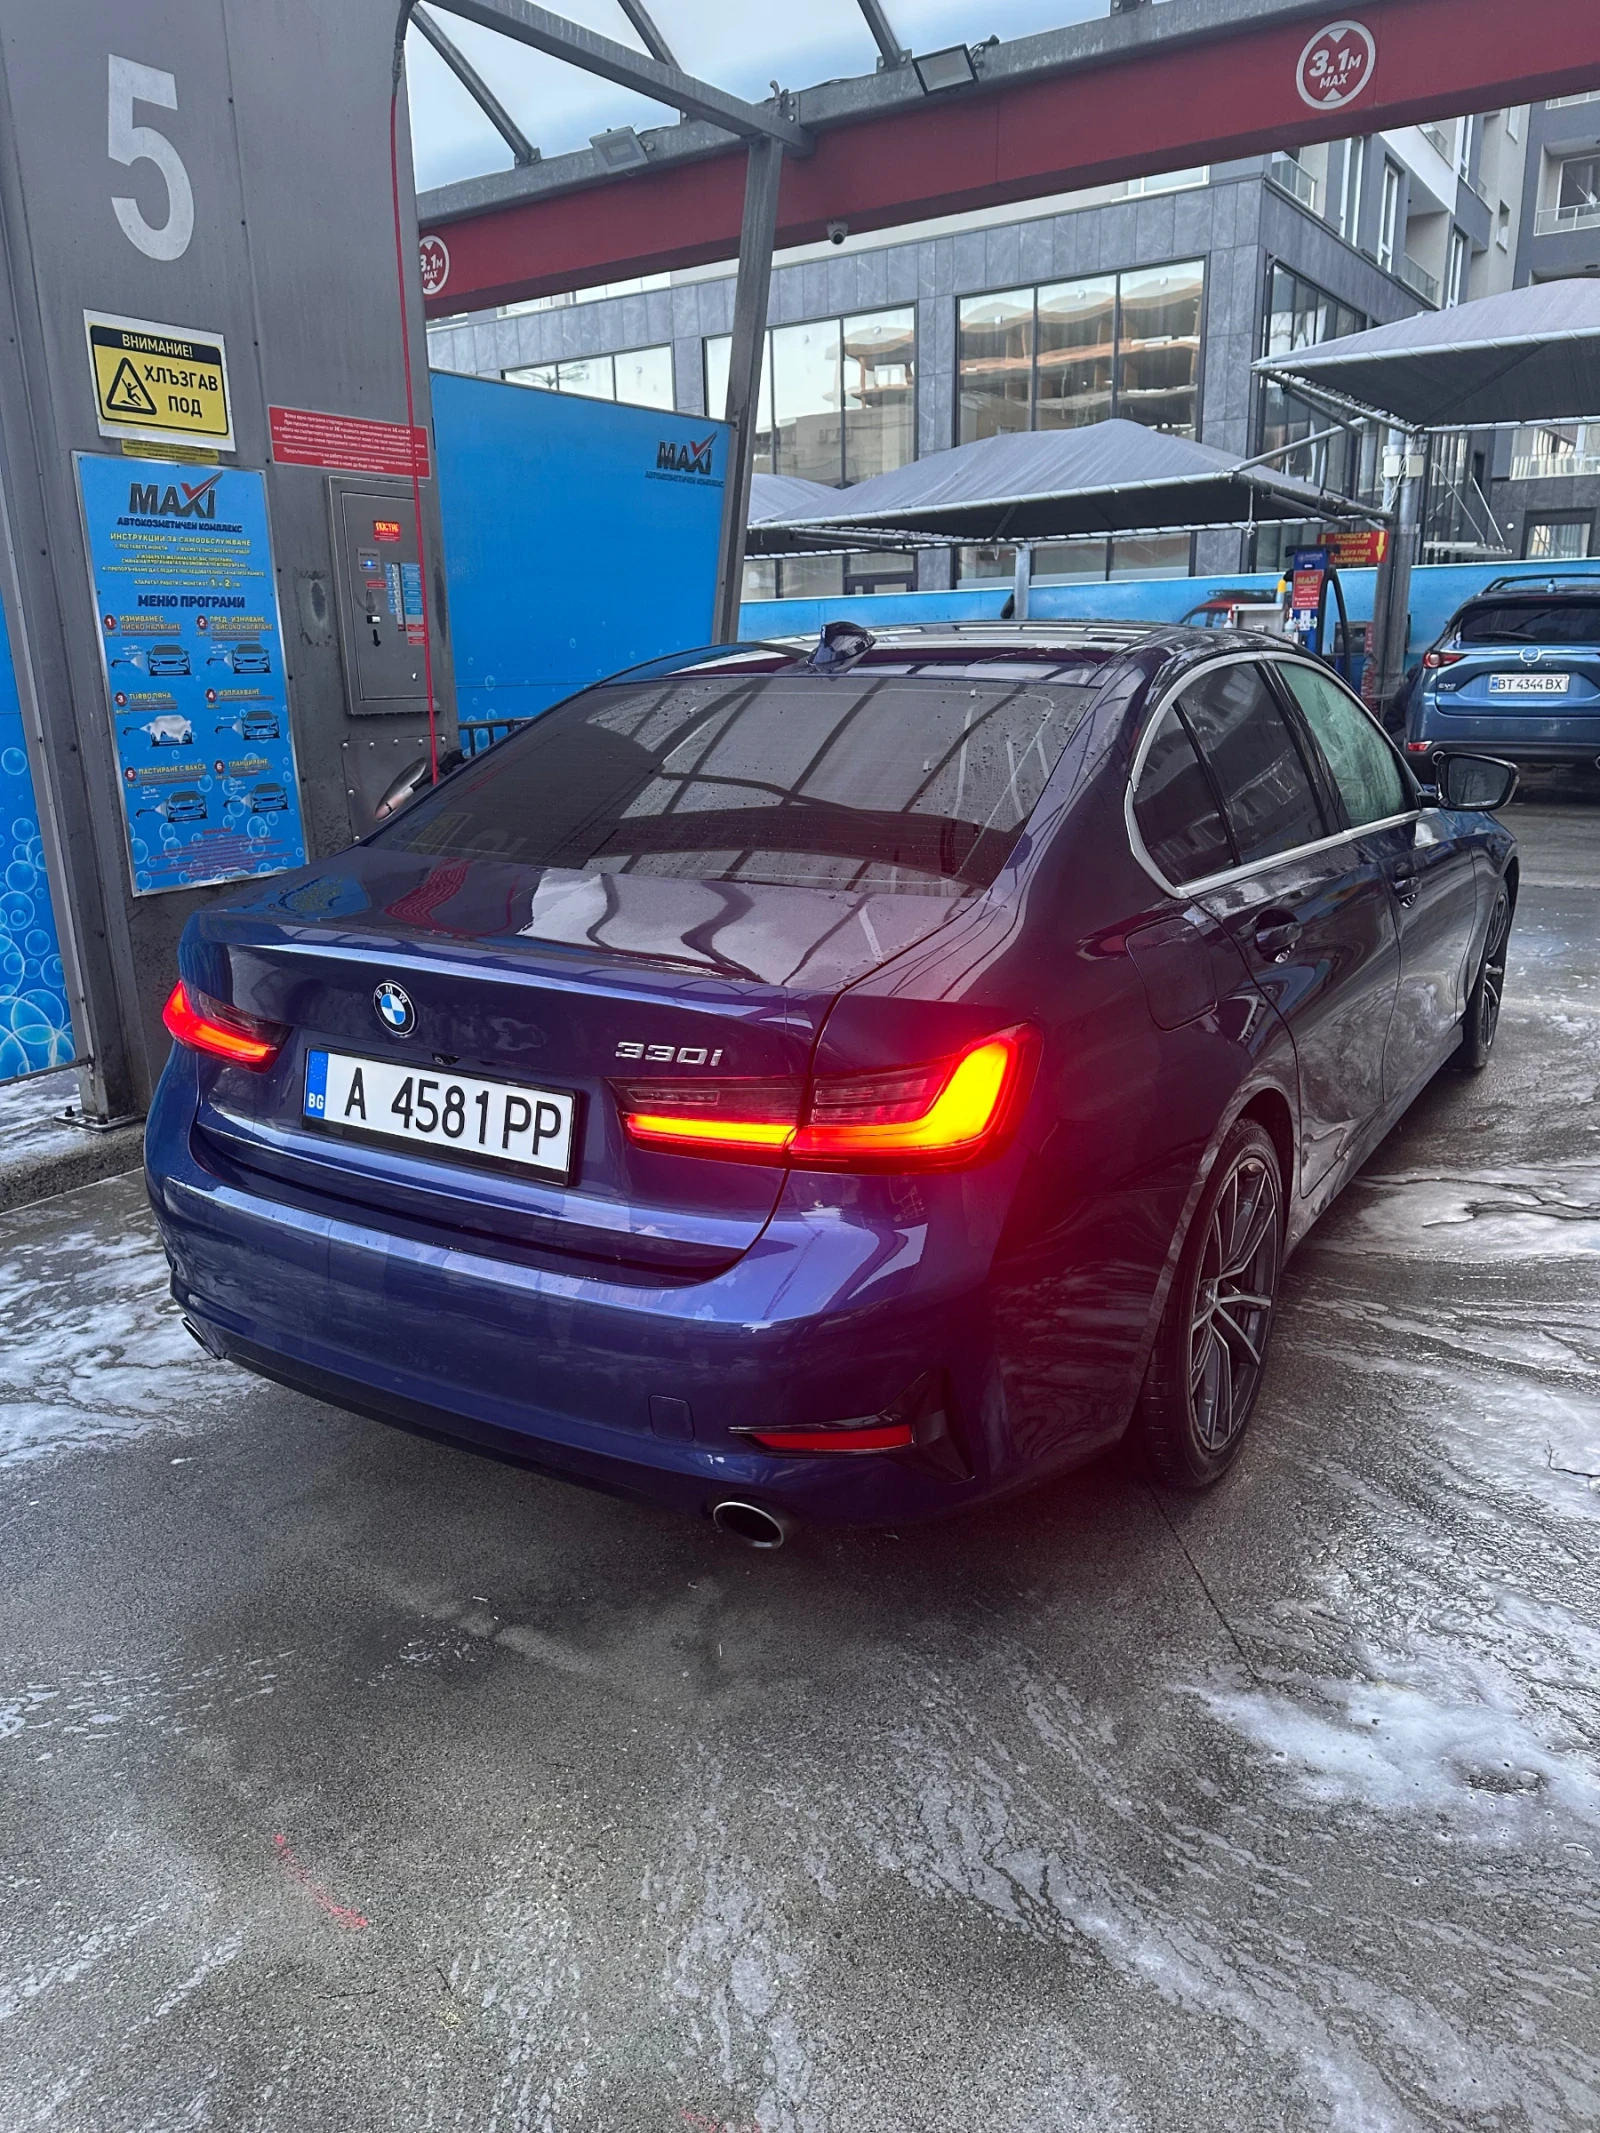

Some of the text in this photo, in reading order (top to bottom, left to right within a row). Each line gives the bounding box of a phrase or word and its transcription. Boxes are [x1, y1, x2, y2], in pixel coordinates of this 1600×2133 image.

[1319, 72, 1348, 88] MAX
[108, 53, 194, 261] 5
[424, 270, 438, 280] MAX
[122, 333, 193, 358] ВНИМАНИЕ!
[144, 365, 218, 391] ХЛЪЗГАВ
[168, 395, 203, 418] ПОД
[657, 435, 715, 475] MAXI
[129, 475, 220, 518] MAXI
[117, 517, 242, 533] АВТОКОЗМЕТИЧЕН КОМПЛЕКС
[110, 532, 165, 542] ИНСТРУКЦИИ
[179, 536, 251, 546] САМООБСЛУЖВАНЕ
[138, 595, 245, 608] МЕНЮ ПРОГРАМИ
[219, 688, 260, 696] ИЗПЛАКВАНЕ
[1498, 679, 1562, 690] BT 4344 BX
[138, 765, 178, 775] ПАСТИРАНЕ
[185, 763, 206, 771] ВАКСА
[228, 758, 268, 768] ГЛАНЦИРАНЕ
[375, 984, 408, 1004] BMW
[615, 1041, 723, 1067] 330i
[308, 1091, 325, 1110] BG
[344, 1066, 368, 1120] A
